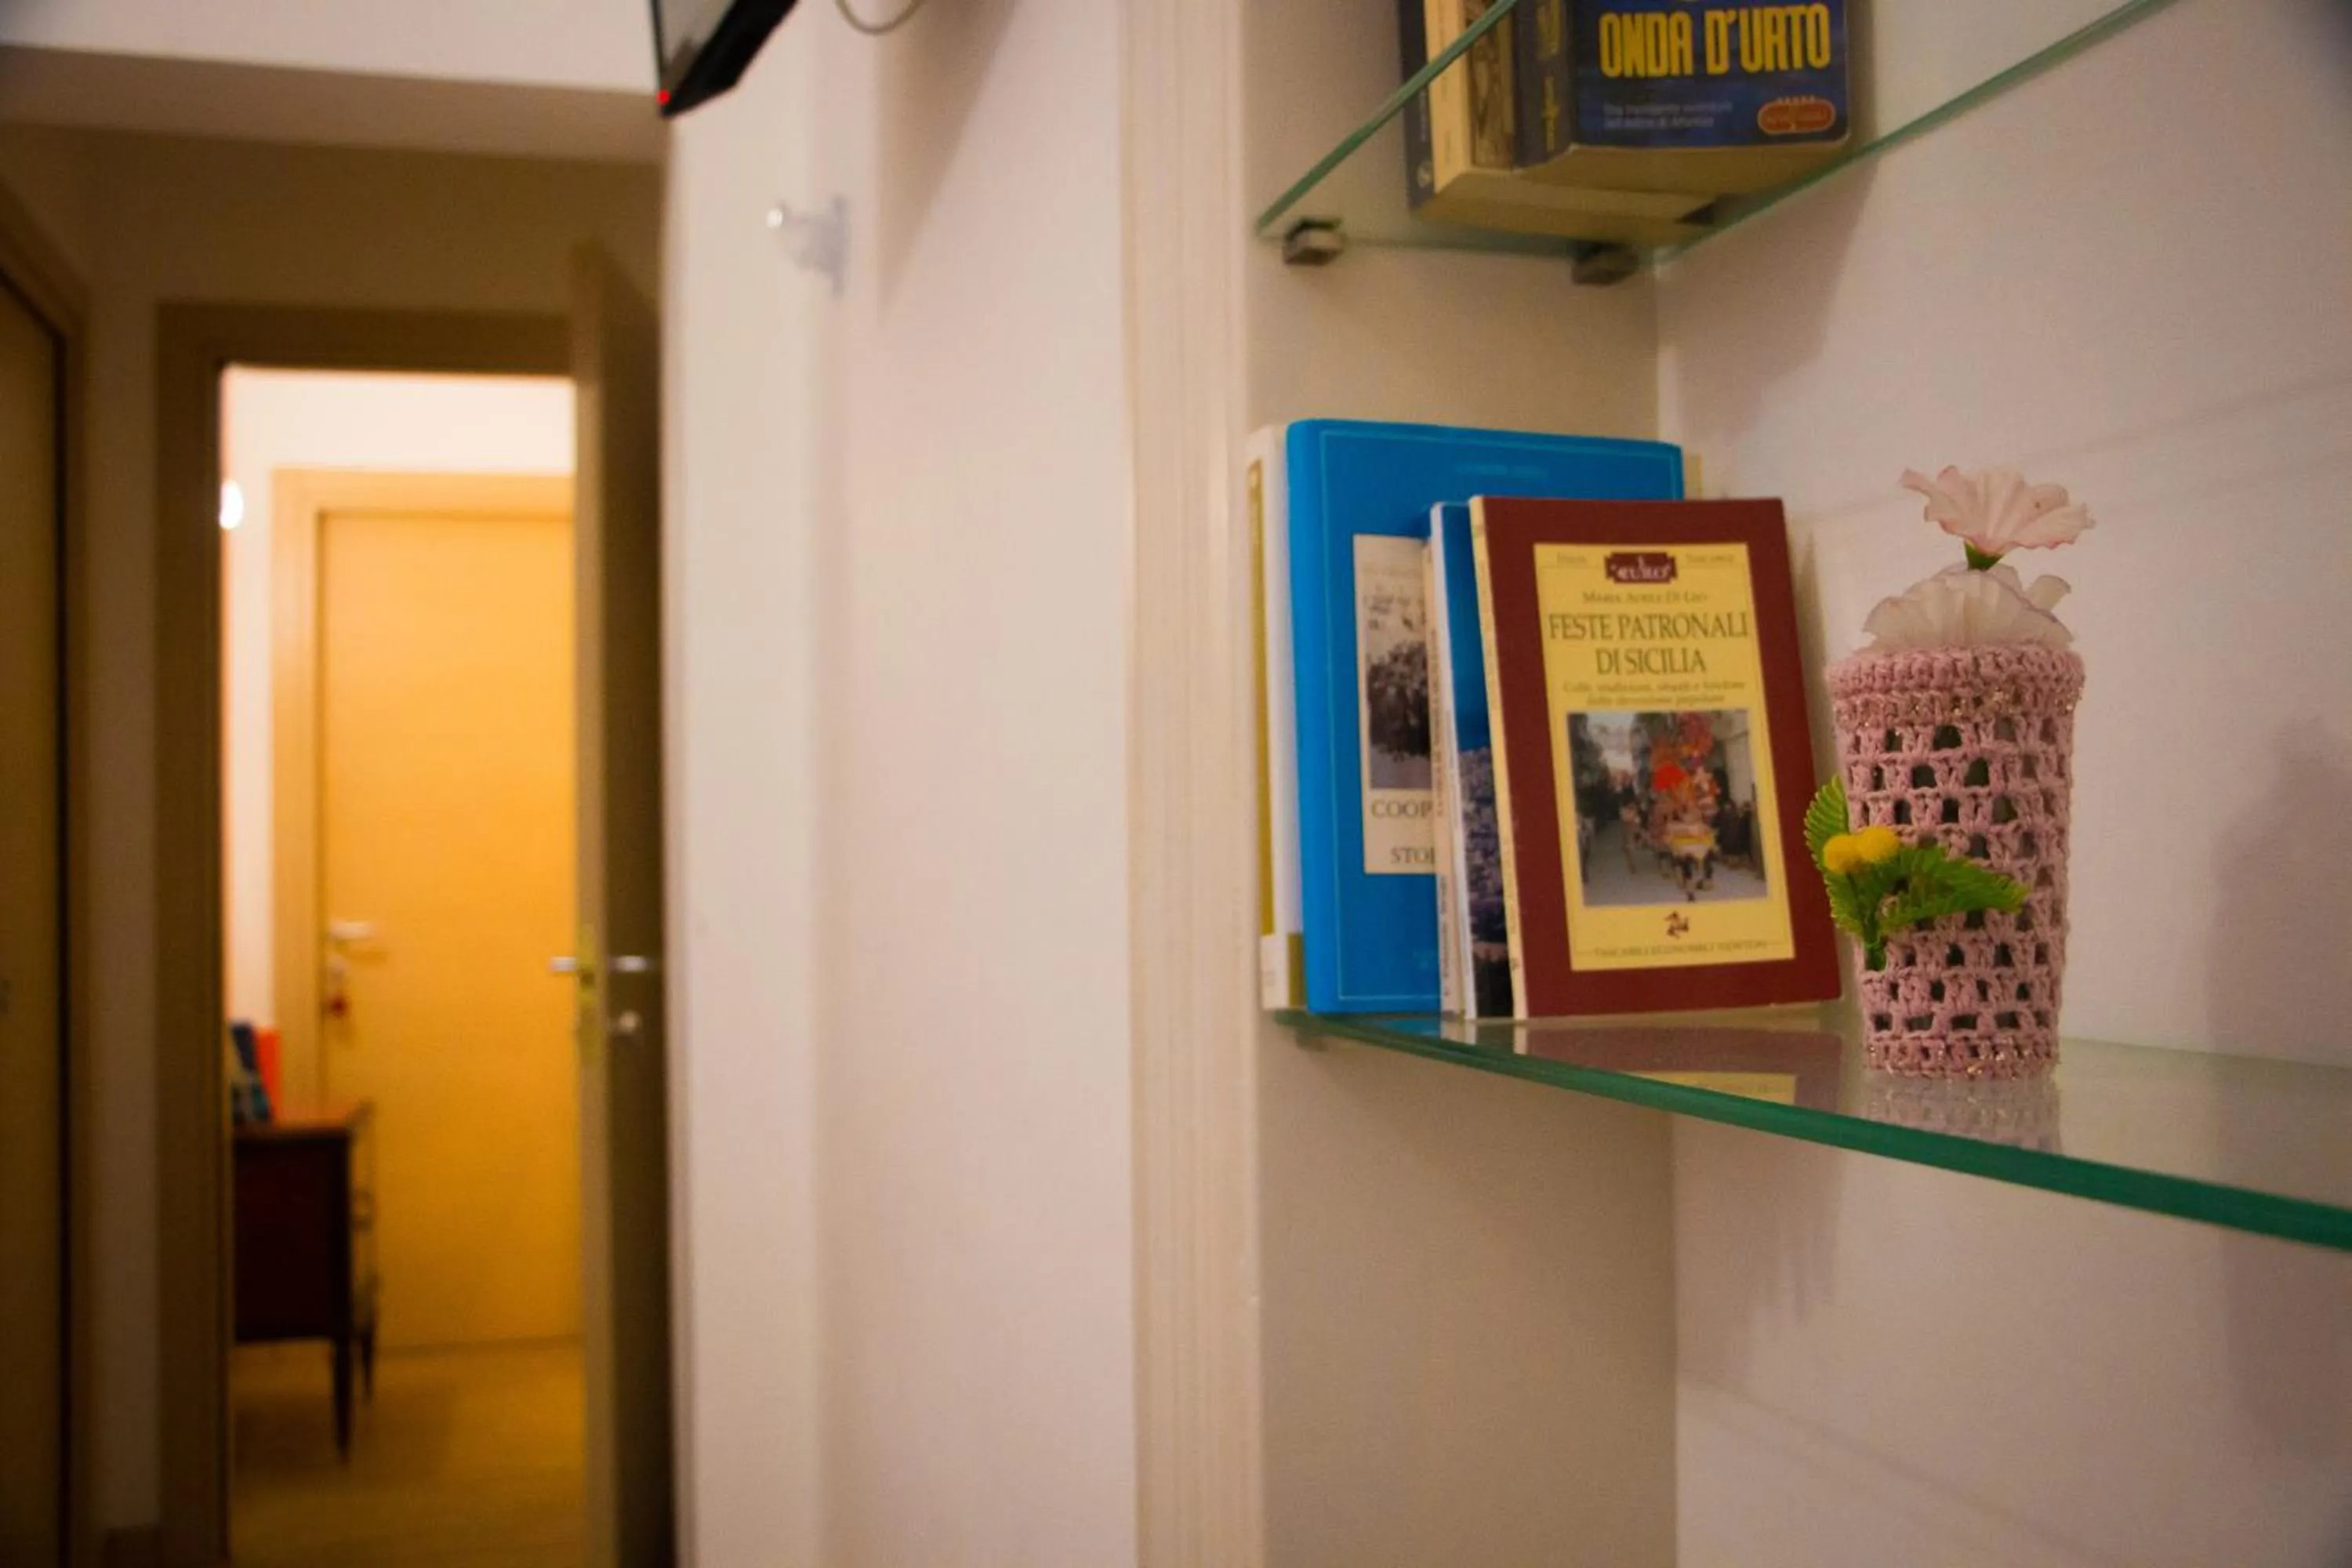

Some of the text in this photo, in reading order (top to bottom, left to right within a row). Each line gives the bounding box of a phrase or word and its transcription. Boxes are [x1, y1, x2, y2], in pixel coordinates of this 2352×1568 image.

[1599, 11, 1693, 78] ONDA
[1704, 2, 1831, 75] D'URTO
[1548, 611, 1748, 640] FESTE PATRONALI
[1595, 646, 1706, 675] DI SICILIA
